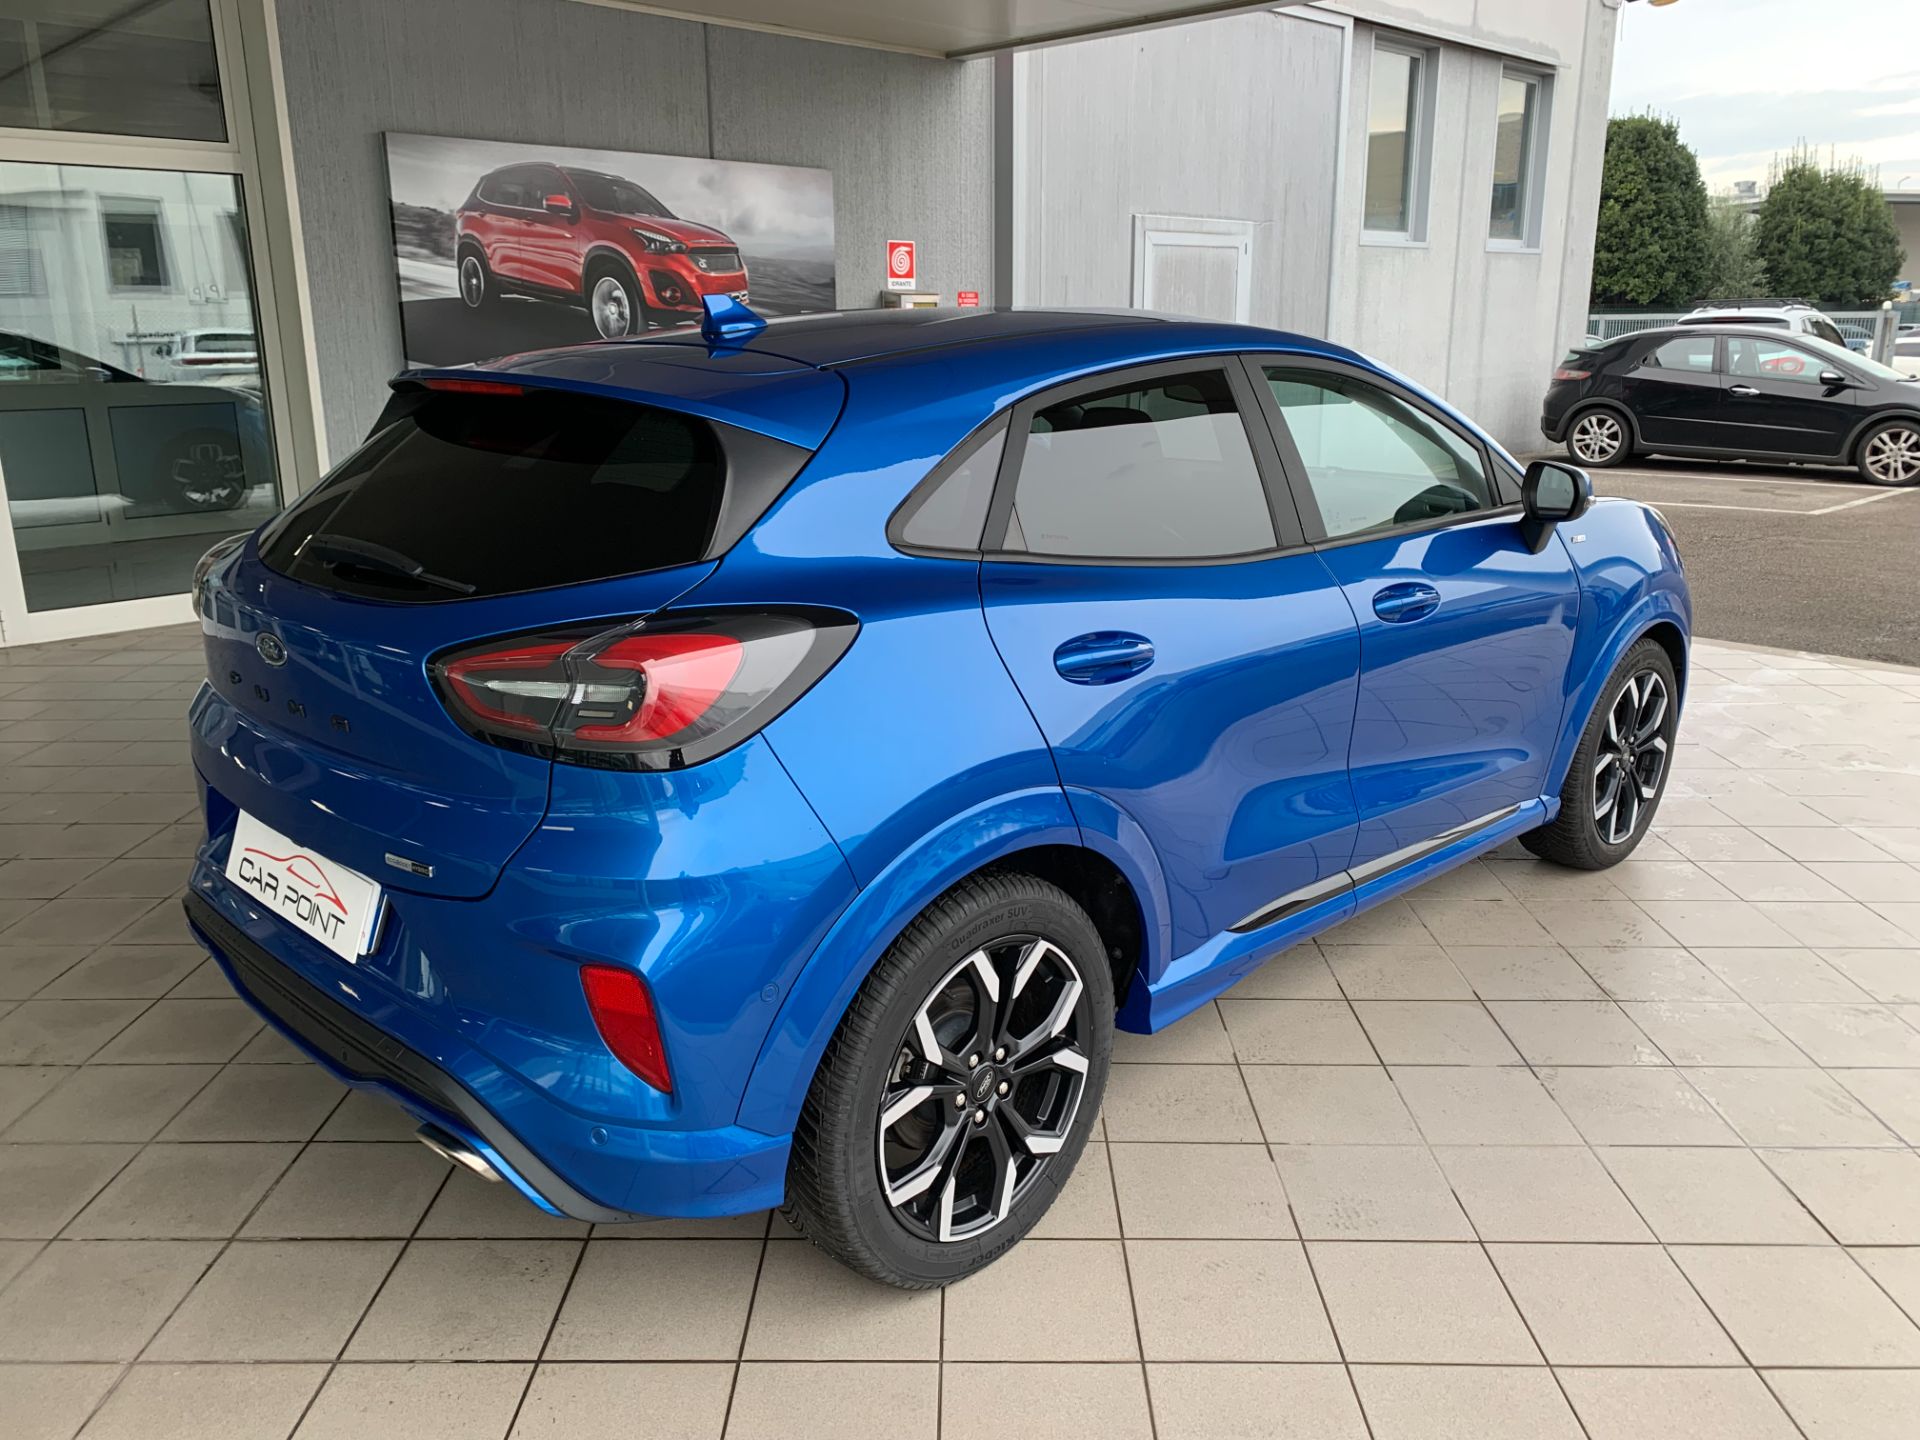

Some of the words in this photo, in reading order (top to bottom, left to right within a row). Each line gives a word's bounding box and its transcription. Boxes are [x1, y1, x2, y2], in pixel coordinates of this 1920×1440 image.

[238, 857, 280, 900] CAR
[282, 885, 346, 940] POINT
[951, 913, 1004, 949] Quadraxer
[1007, 906, 1028, 919] SUV
